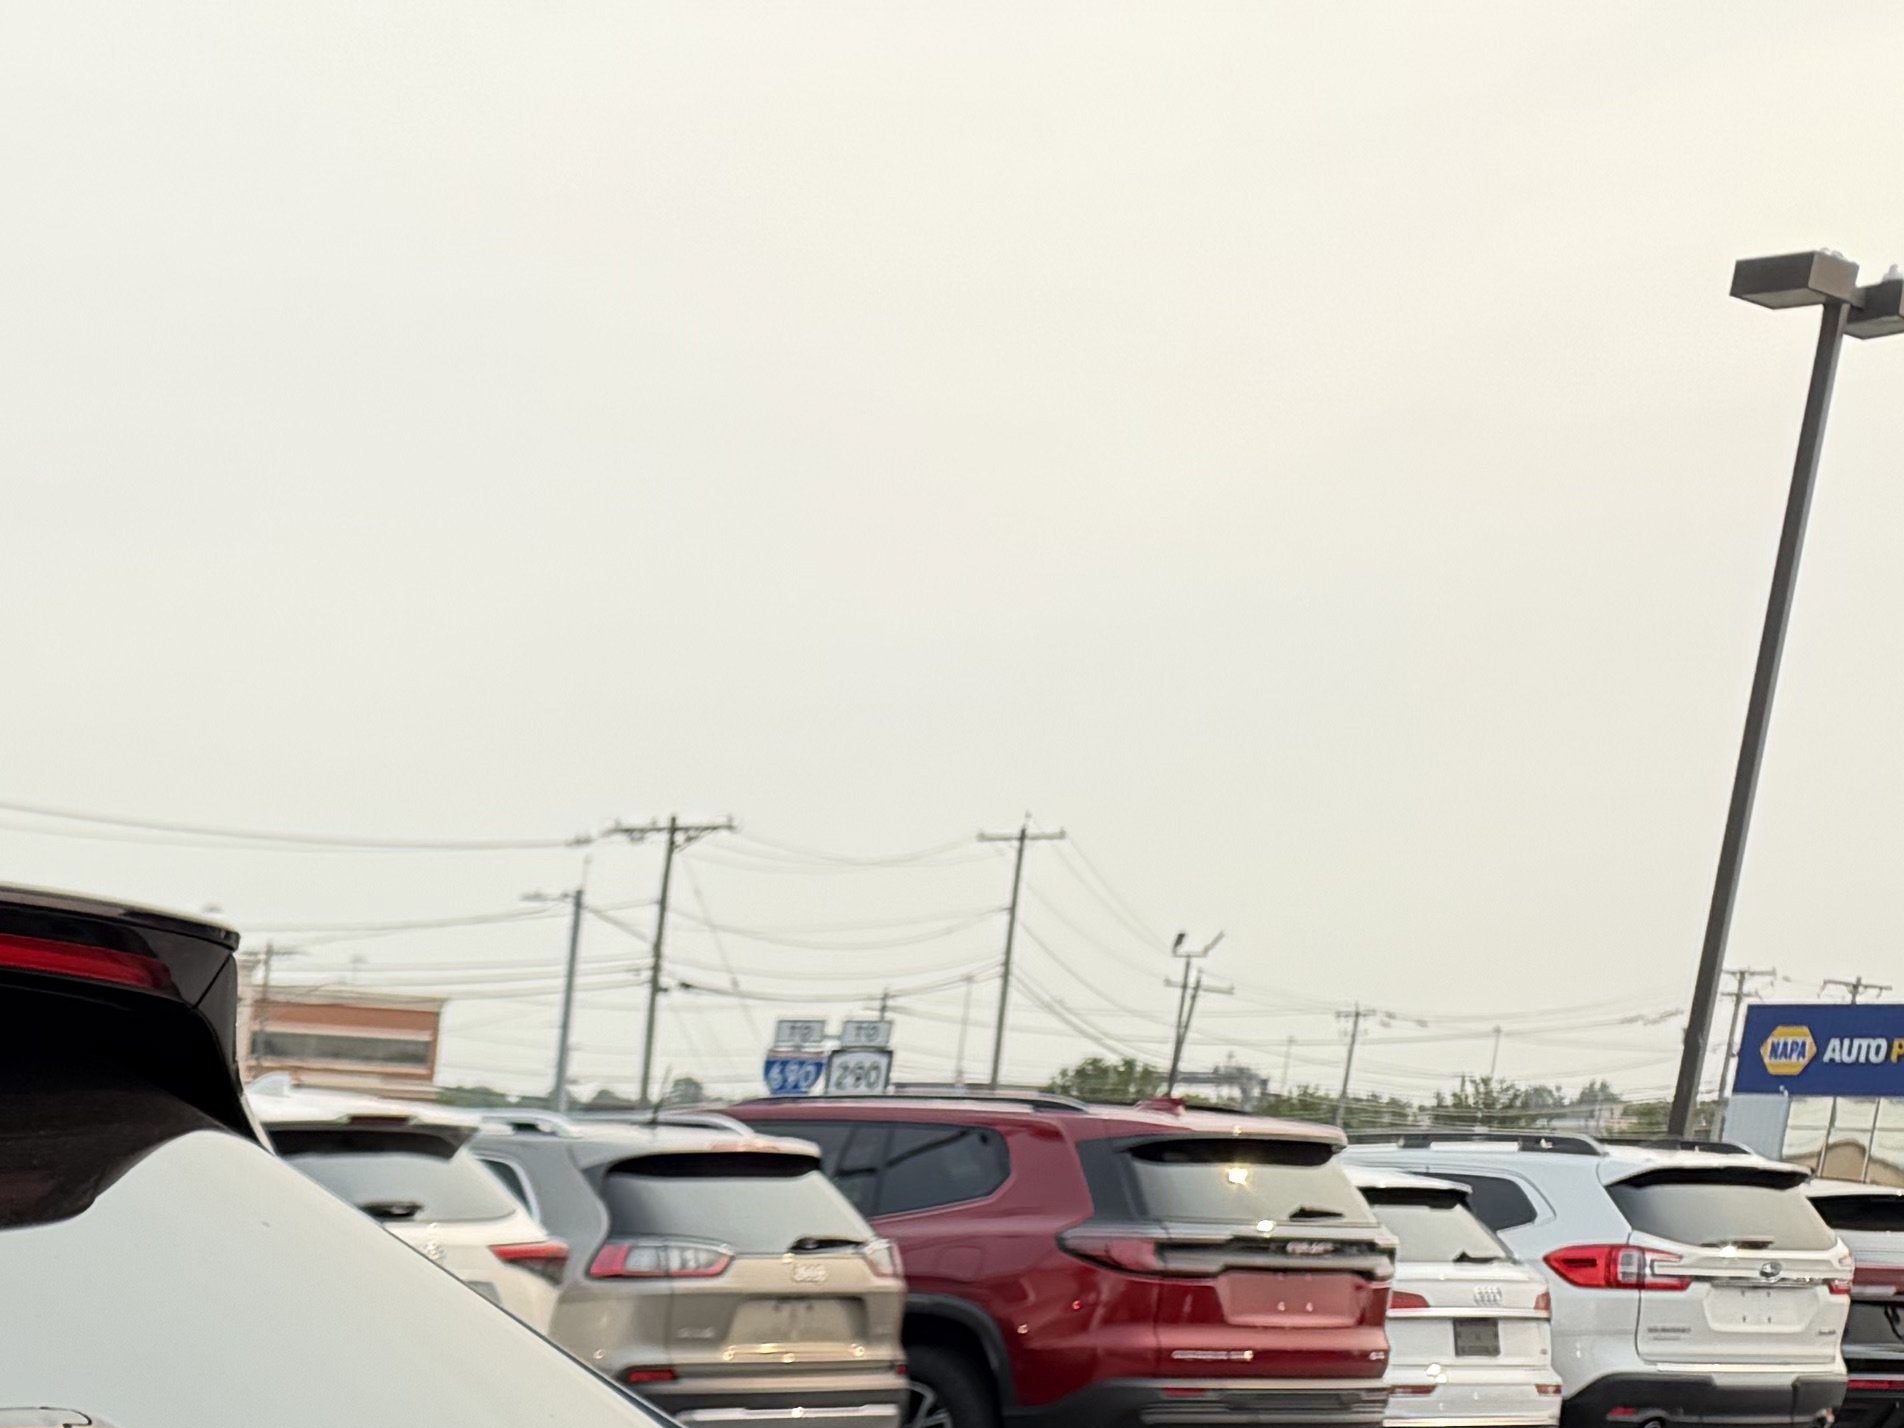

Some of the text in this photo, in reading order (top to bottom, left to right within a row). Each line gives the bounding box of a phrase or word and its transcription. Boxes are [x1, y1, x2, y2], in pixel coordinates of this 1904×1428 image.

[1769, 1039, 1808, 1061] NAPA
[1823, 1037, 1888, 1064] AUTO
[768, 1061, 817, 1090] 690
